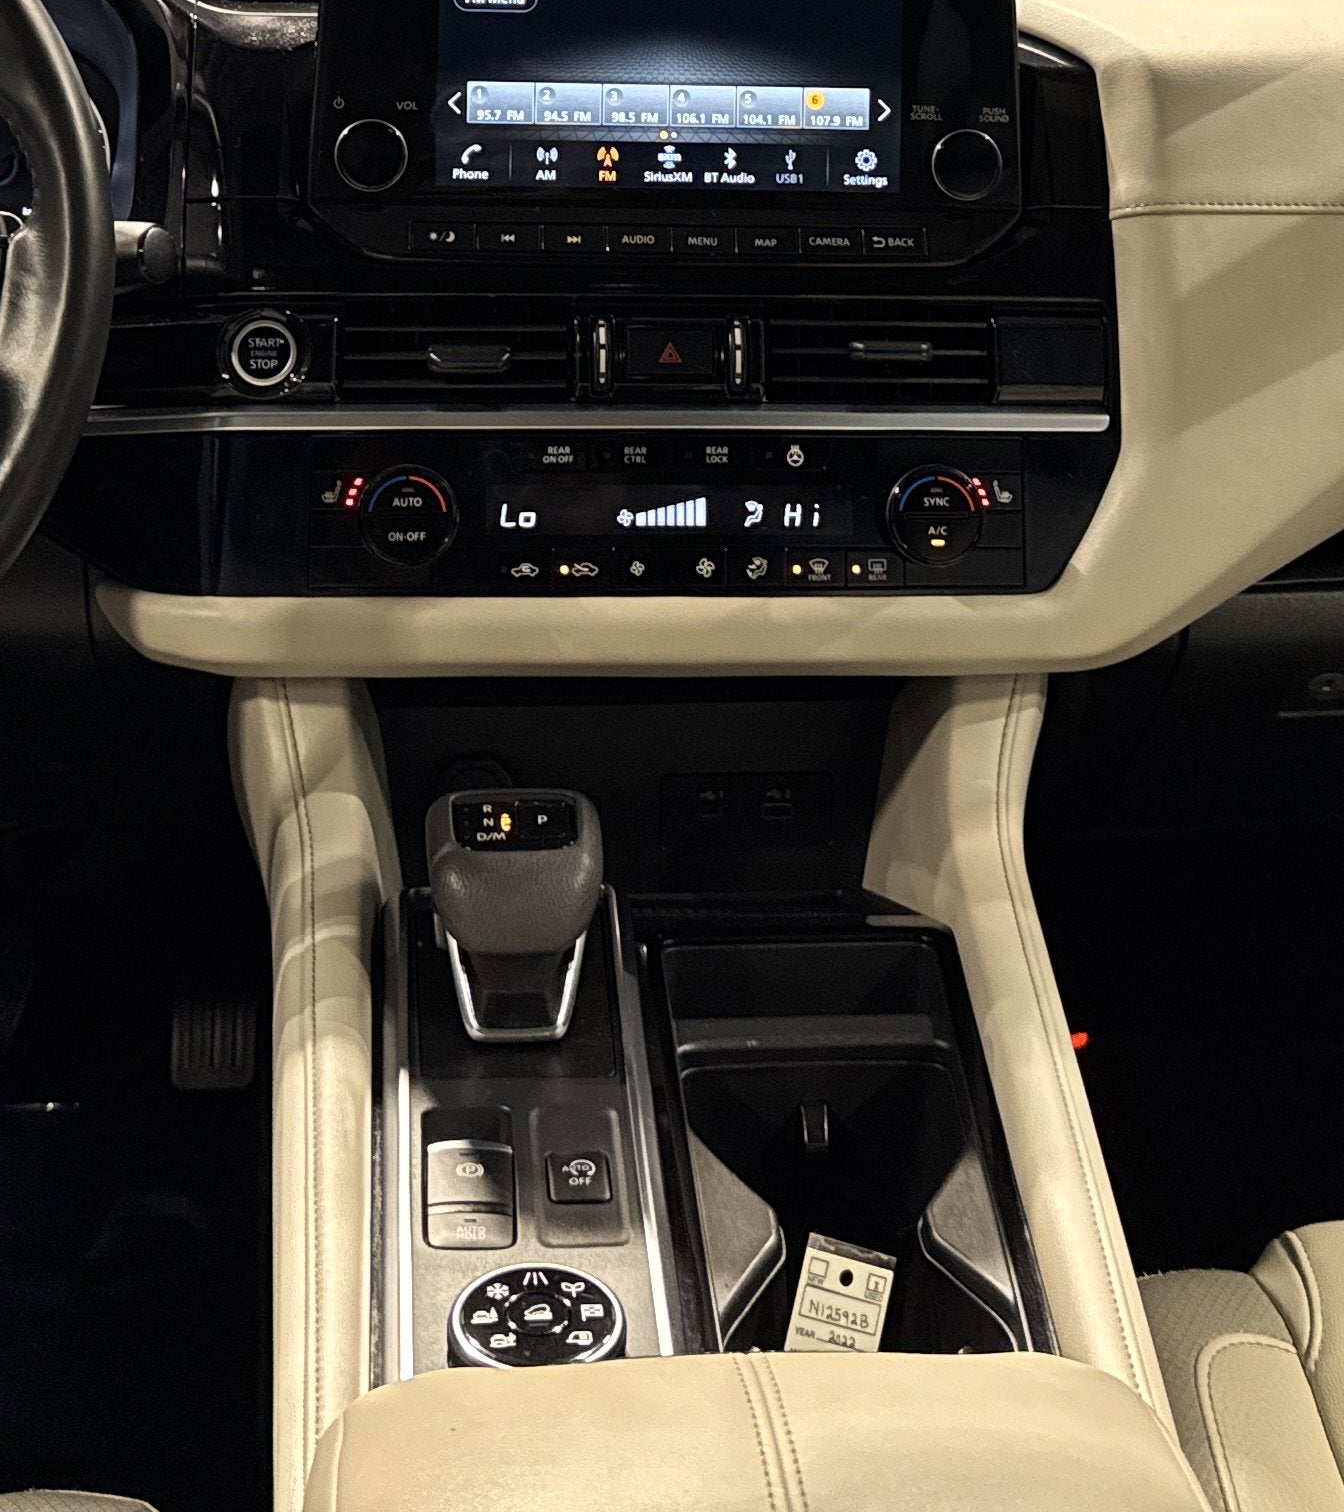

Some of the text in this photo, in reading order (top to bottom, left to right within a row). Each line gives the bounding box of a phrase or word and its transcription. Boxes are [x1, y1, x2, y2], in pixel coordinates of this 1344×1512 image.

[396, 101, 418, 111] VOL
[476, 109, 525, 121] 95.7 FM
[543, 111, 592, 122] 94.5 FM
[611, 112, 659, 123] 98.5 FM
[676, 113, 730, 125] 106.1 FM
[743, 114, 796, 126] 104.1 FM
[910, 113, 943, 121] SCROLL
[979, 114, 1009, 122] SOUND
[810, 115, 864, 127] 107.9 FM
[452, 168, 489, 181] Phone
[535, 170, 557, 181] AM
[598, 171, 617, 182] FM
[644, 171, 693, 183] SiriusXM
[704, 172, 756, 184] BT Audio
[843, 174, 888, 188] Settings
[622, 234, 655, 245] AUDIO
[688, 236, 718, 247] MENU
[754, 237, 777, 248] MAP
[809, 236, 851, 247] CAMERA
[888, 237, 915, 247] BACK
[247, 337, 280, 348] START
[249, 358, 278, 369] STOP
[547, 445, 571, 454] REAR
[624, 446, 647, 455] REAR
[705, 445, 729, 455] REAR
[623, 455, 646, 464] CTRL
[705, 455, 729, 464] LOCK
[392, 497, 423, 507] AUTO
[923, 496, 950, 507] SYNC
[499, 503, 537, 528] Lo
[783, 503, 820, 527] Hi
[927, 525, 948, 536] A/C
[808, 573, 832, 582] FRONT
[868, 573, 887, 582] REAR
[482, 804, 493, 813] R
[483, 817, 494, 827] N
[537, 814, 548, 825] P
[476, 831, 506, 842] D/M
[568, 1177, 593, 1186] OFF
[456, 1225, 486, 1233] AUTO
[456, 1232, 487, 1240] HOLD
[795, 1326, 816, 1339] YEAR
